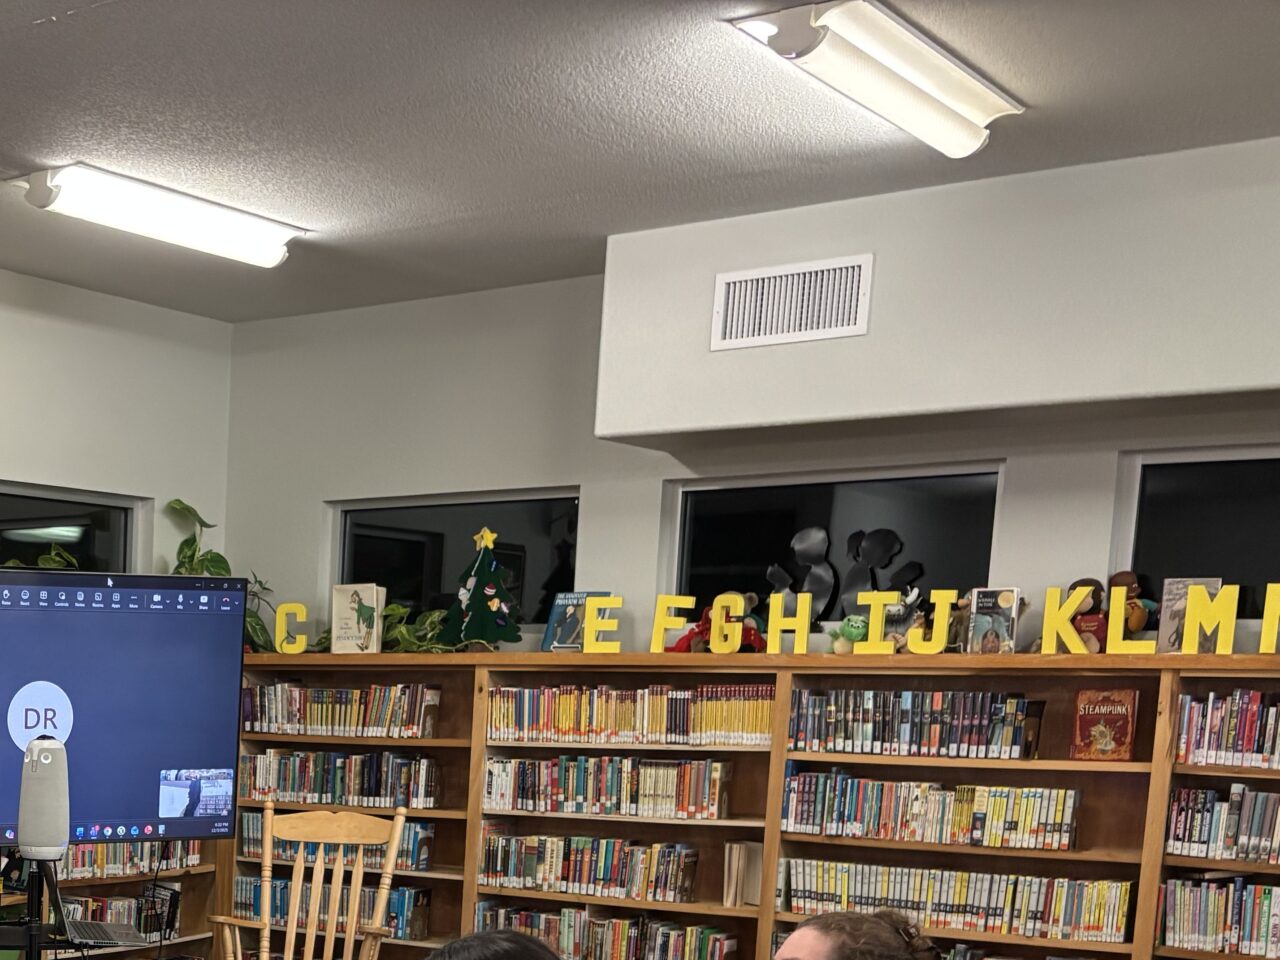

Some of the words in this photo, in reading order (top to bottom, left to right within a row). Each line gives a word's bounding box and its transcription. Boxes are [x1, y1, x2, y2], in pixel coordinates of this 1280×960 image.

[275, 602, 308, 655] C
[583, 596, 623, 654] E
[650, 594, 697, 654] F
[709, 594, 746, 655] G
[766, 592, 813, 655] H
[852, 591, 902, 655] I
[906, 590, 959, 655] J
[1041, 586, 1096, 655] K
[1105, 585, 1157, 655] L
[1181, 584, 1241, 655] M
[24, 707, 58, 730] DR
